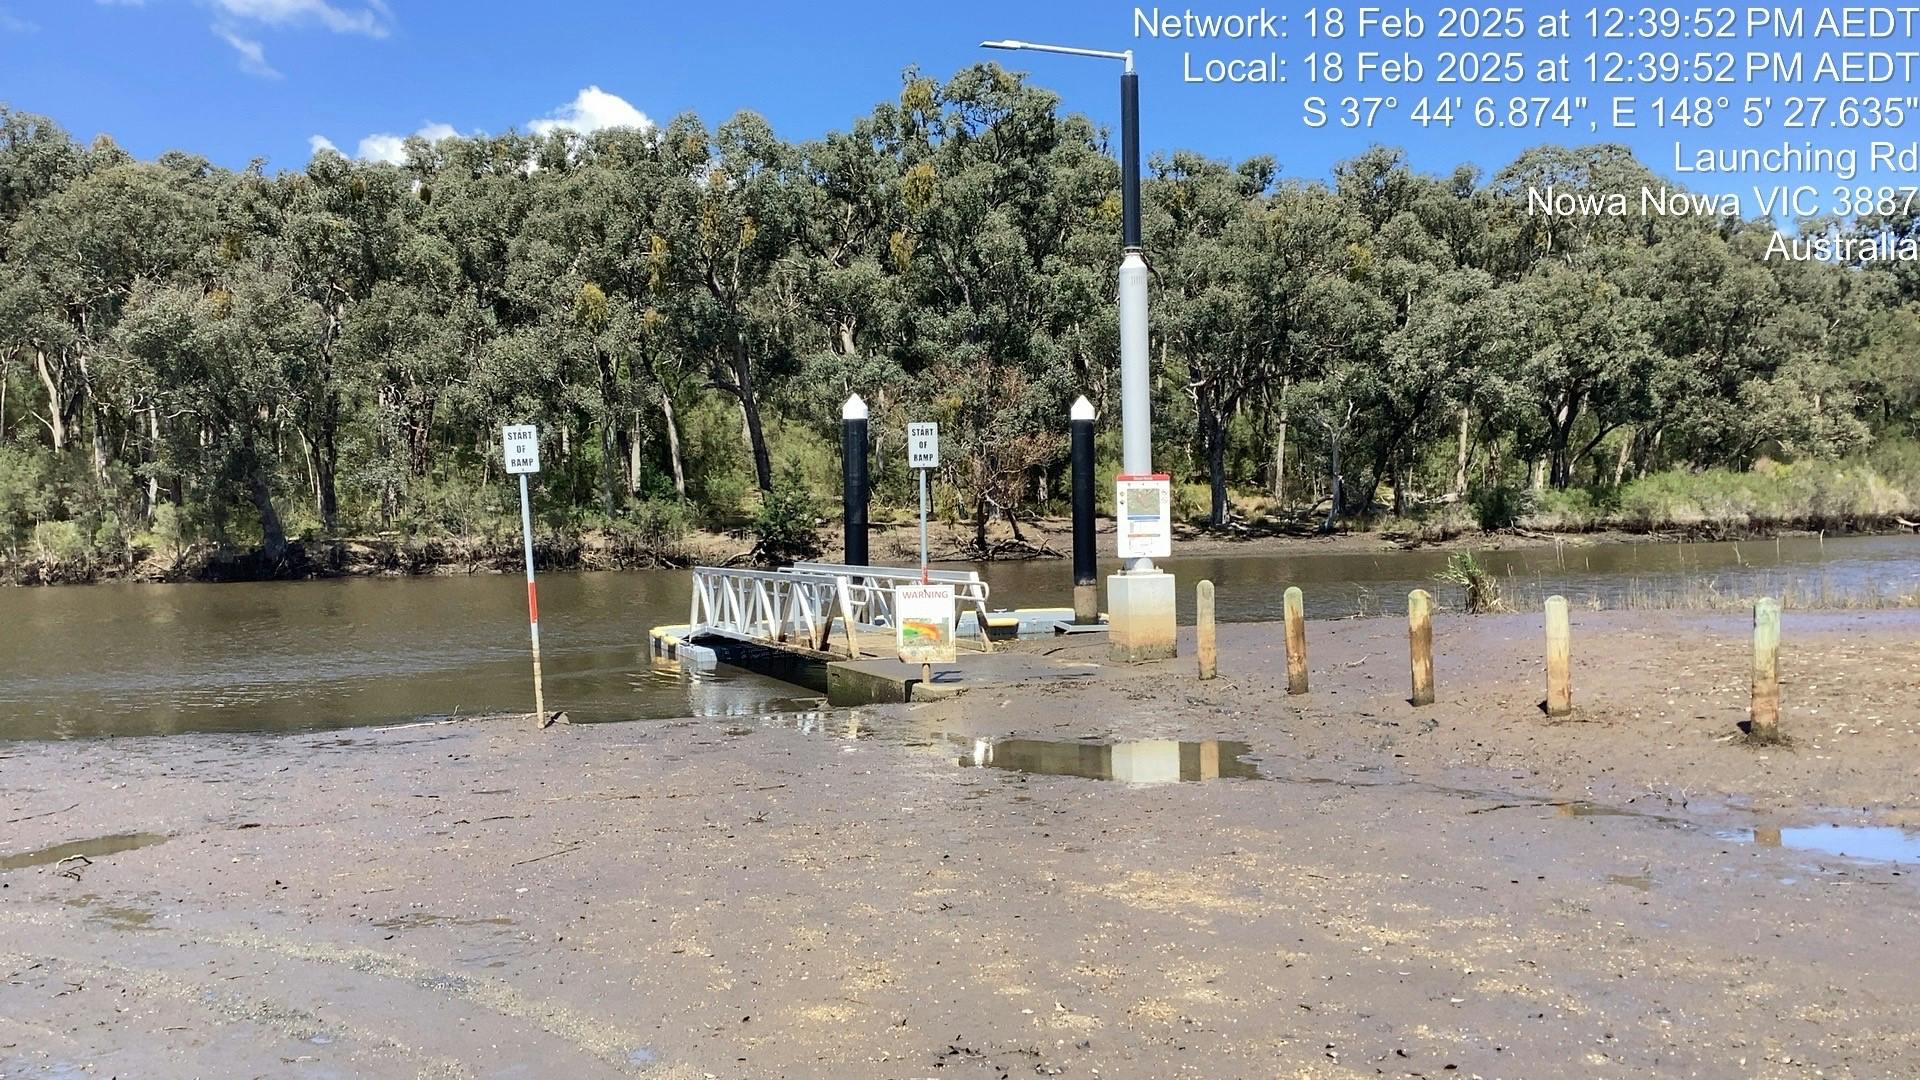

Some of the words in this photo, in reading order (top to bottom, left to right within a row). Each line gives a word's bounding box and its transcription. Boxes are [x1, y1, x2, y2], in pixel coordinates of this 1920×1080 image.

[507, 431, 532, 440] START
[911, 428, 934, 437] START
[516, 444, 526, 454] OF
[918, 441, 928, 449] OF
[913, 453, 934, 462] RAMP
[510, 458, 534, 467] RAMP
[902, 590, 949, 599] WARNING
